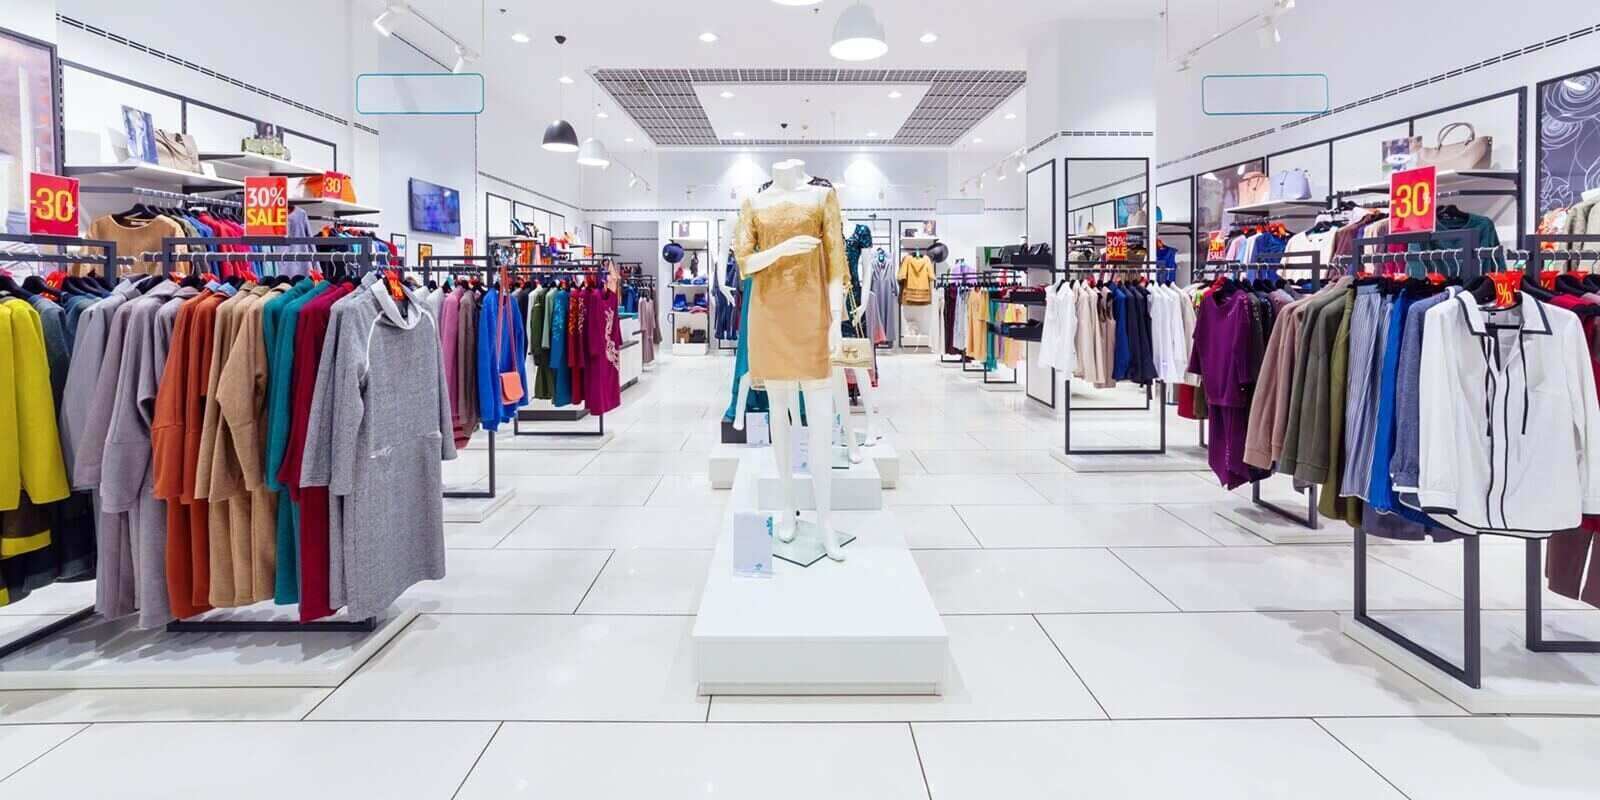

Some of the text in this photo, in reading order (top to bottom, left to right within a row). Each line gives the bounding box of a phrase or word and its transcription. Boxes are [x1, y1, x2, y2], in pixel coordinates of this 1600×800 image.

[247, 187, 286, 208] 30%
[246, 207, 286, 226] SALE
[1106, 247, 1127, 257] SALE
[1497, 282, 1513, 304] %
